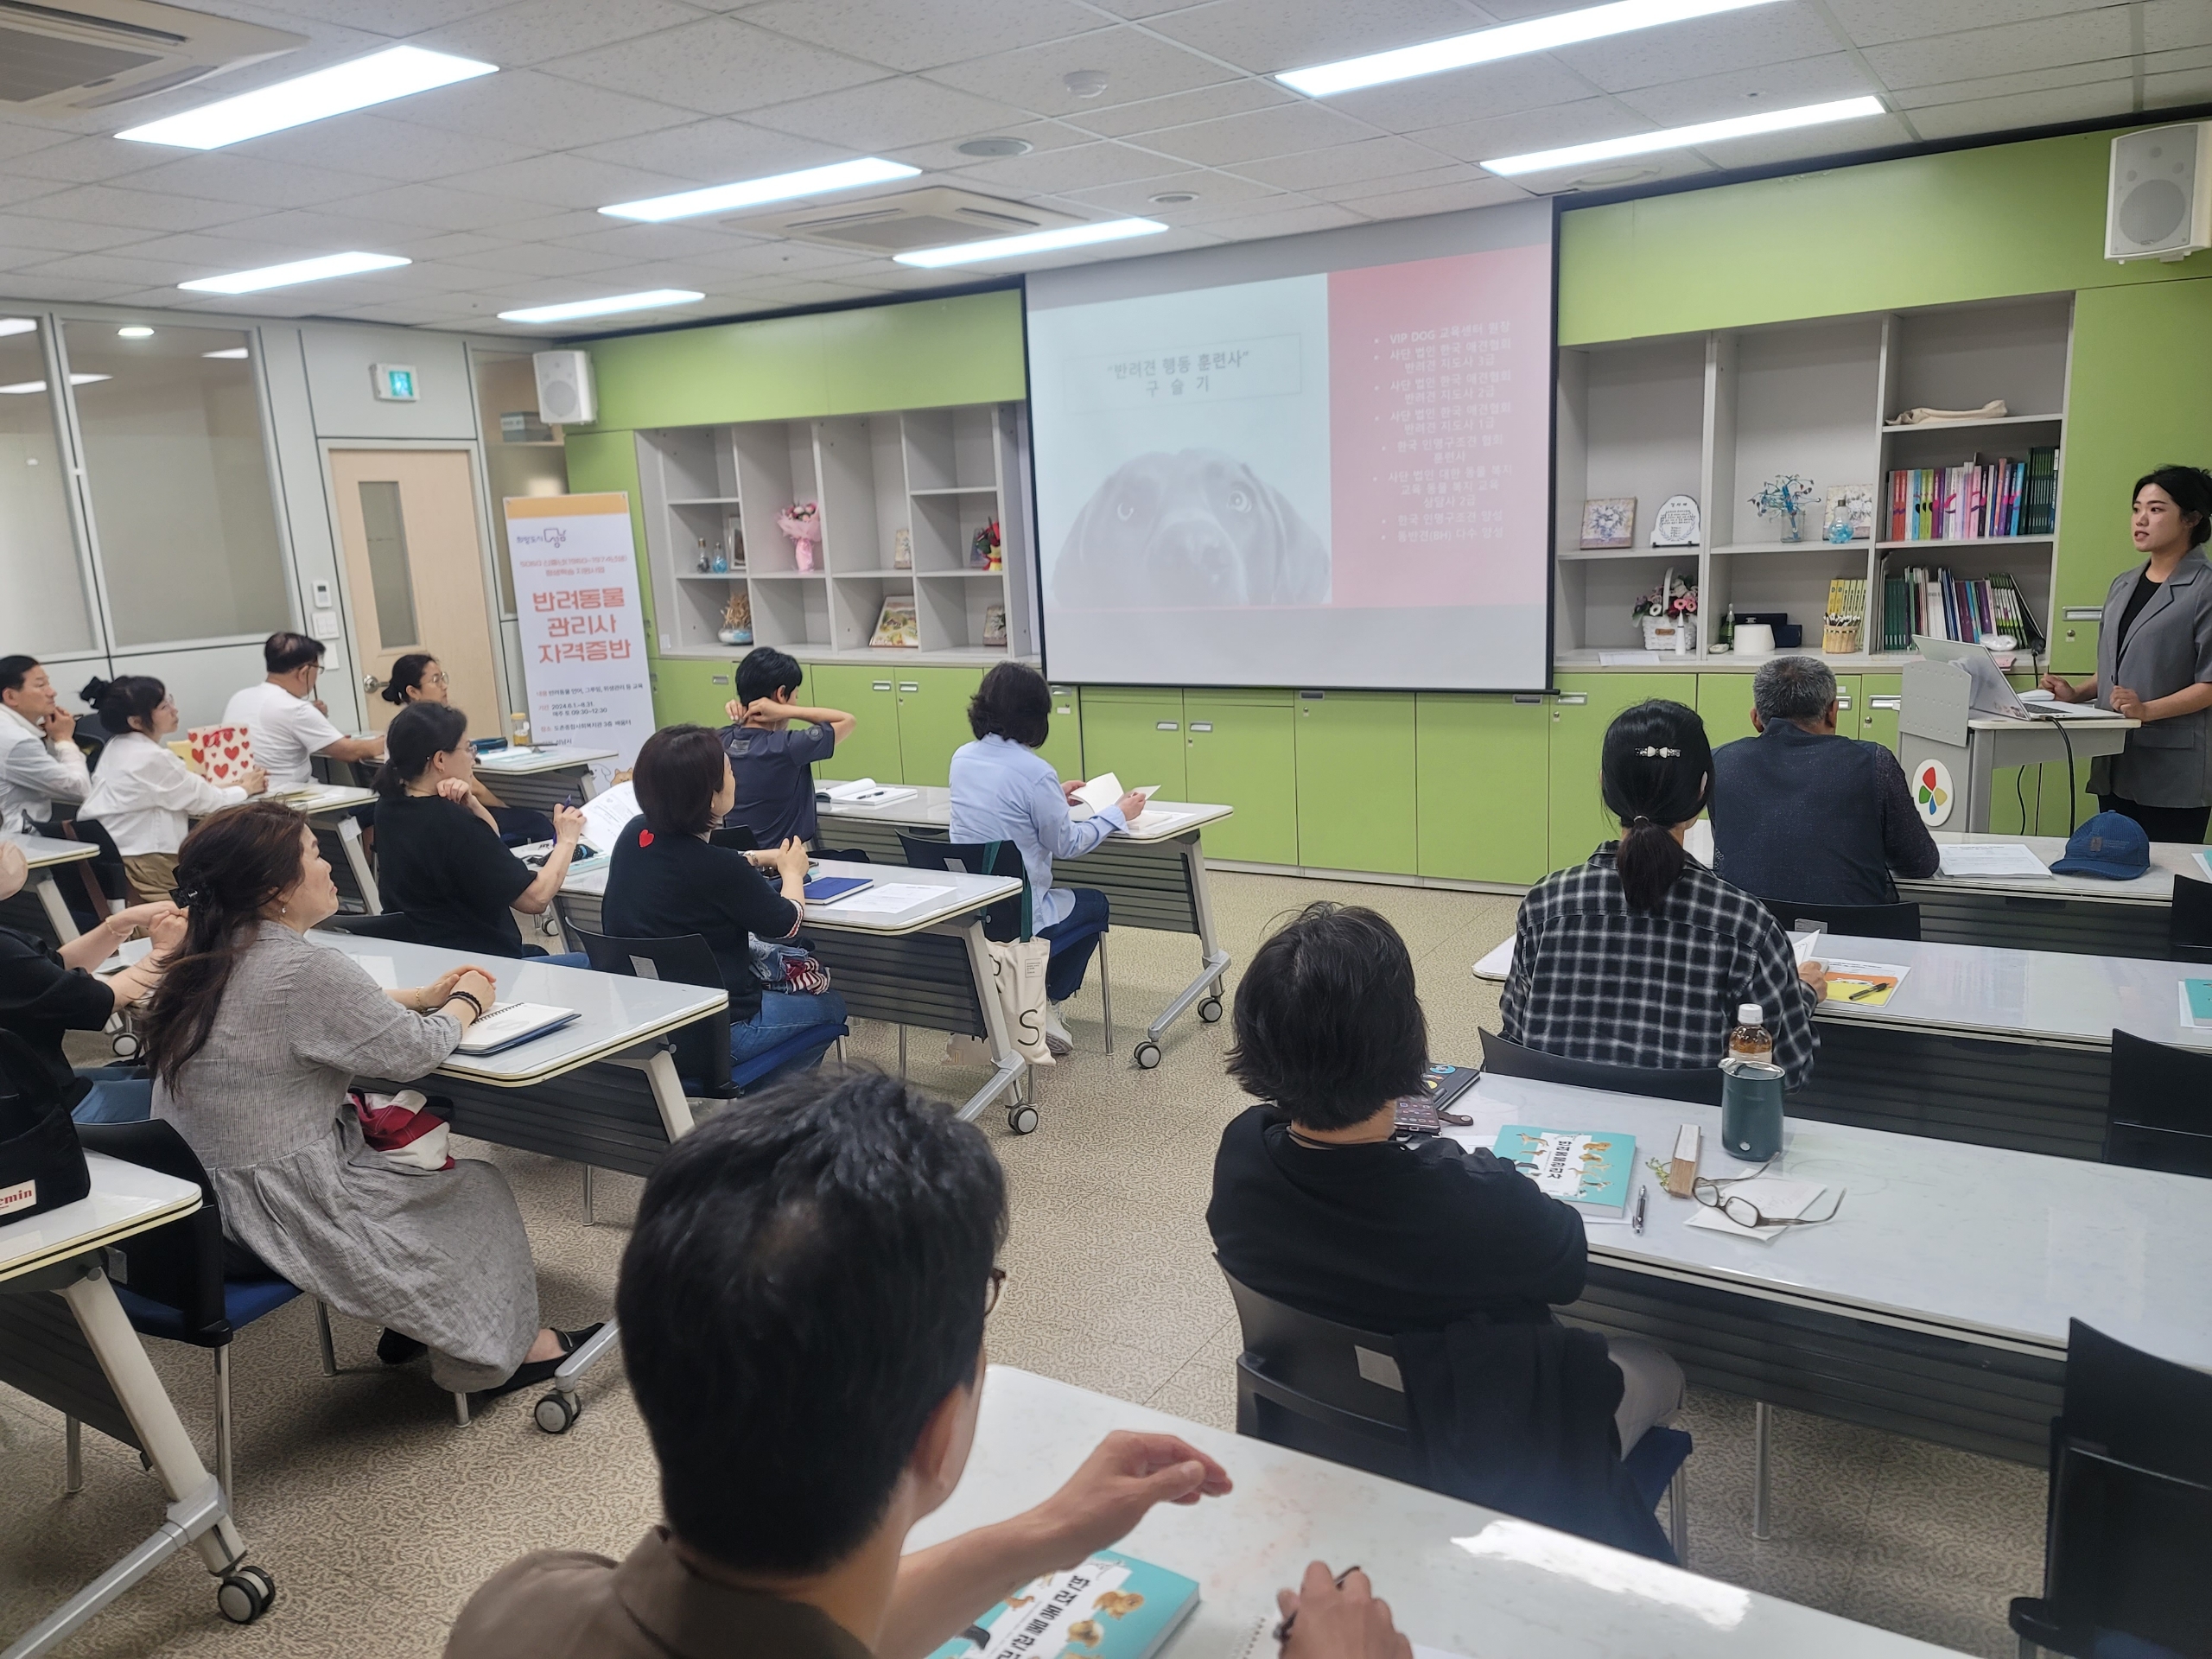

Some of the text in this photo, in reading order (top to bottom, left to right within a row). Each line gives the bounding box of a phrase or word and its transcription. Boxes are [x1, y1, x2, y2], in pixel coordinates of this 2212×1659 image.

[1389, 320, 1511, 344] VIP DOG 교육센터 원장
[1390, 347, 1411, 361] 사단
[1414, 345, 1434, 359] 법인
[1440, 341, 1460, 356] 한국
[1162, 355, 1191, 375] 행동
[1404, 353, 1495, 373] 반려견 지도사 3급
[1390, 379, 1411, 391] 사단
[1414, 377, 1434, 390] 법인
[1440, 373, 1460, 388] 한국
[1404, 385, 1495, 405] 반려견 지도사 2급
[1390, 410, 1411, 423] 사단
[1414, 408, 1434, 421] 법인
[1440, 404, 1460, 419] 한국
[1404, 416, 1495, 435] 반려견 지도사 1급
[1397, 433, 1503, 453] 한국 인명구조견 협회
[1389, 470, 1409, 483] 사단
[1413, 468, 1434, 482] 법인
[1439, 467, 1459, 480] 대한
[1459, 493, 1475, 506] 2급
[1397, 513, 1418, 526] 한국
[532, 587, 626, 613] 반려동물
[547, 613, 617, 638] 관리사
[537, 639, 631, 664] 자격증반
